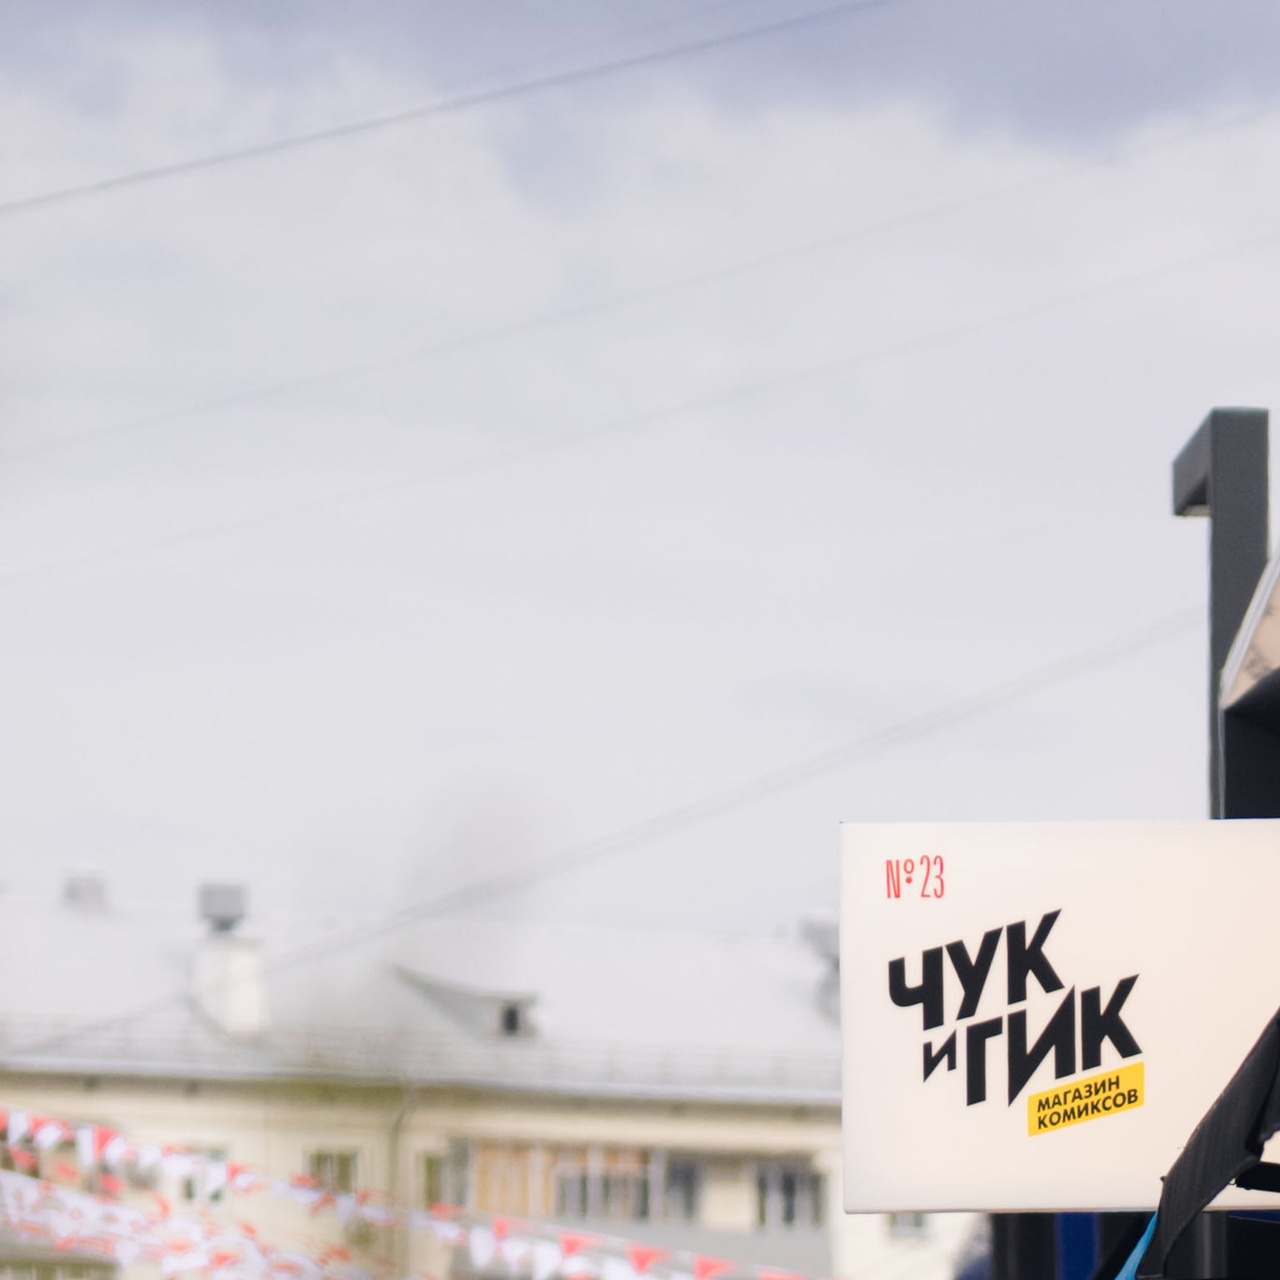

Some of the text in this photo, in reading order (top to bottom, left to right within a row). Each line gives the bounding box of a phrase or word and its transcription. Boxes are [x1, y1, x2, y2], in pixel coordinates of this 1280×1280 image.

[888, 909, 1065, 1031] ЧУК
[966, 974, 1143, 1107] ГИК
[1037, 1075, 1120, 1113] МАГАЗИН
[1037, 1088, 1139, 1130] КОМИКСОВ
